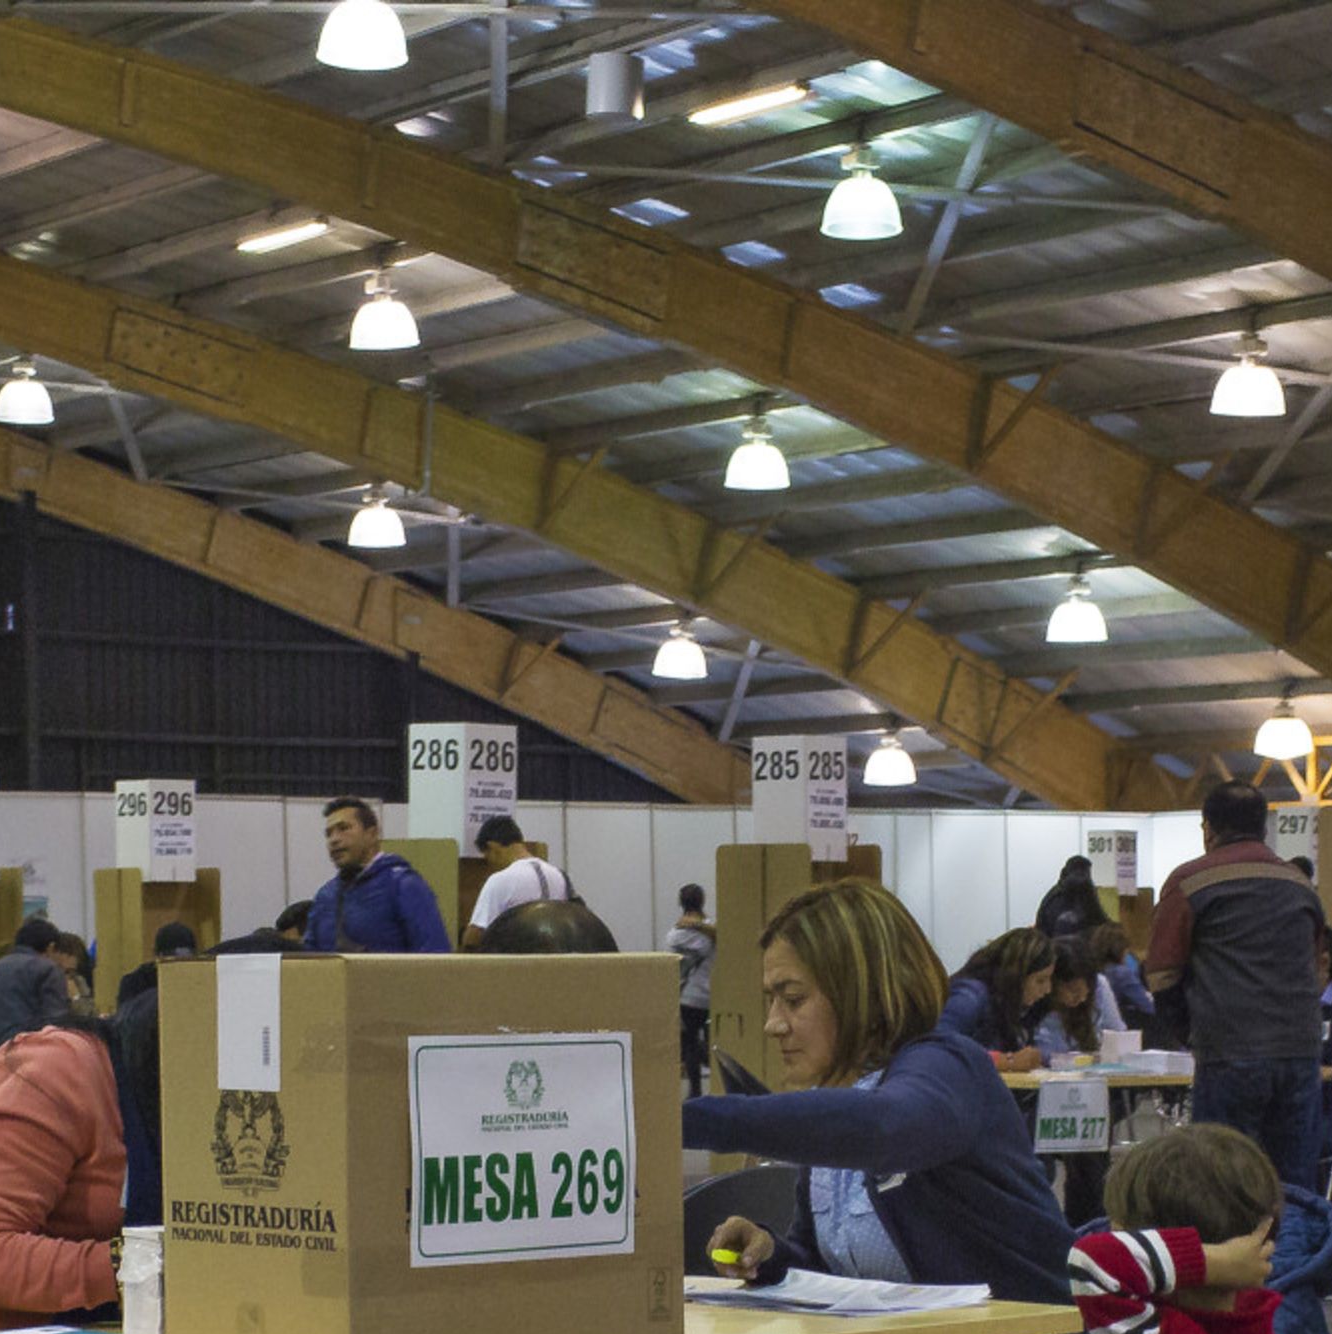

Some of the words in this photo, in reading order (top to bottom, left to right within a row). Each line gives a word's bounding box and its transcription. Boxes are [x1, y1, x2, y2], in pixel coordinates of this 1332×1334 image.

[412, 739, 459, 770] 286
[469, 738, 515, 772] 286
[754, 749, 799, 780] 285
[809, 751, 844, 780] 285
[117, 792, 147, 816] 296
[153, 791, 193, 816] 296
[1278, 814, 1308, 834] 297
[1088, 836, 1113, 853] 301
[1039, 1116, 1077, 1139] MESA
[1081, 1117, 1106, 1139] 277
[423, 1151, 539, 1226] MESA
[551, 1148, 625, 1218] 269
[171, 1200, 337, 1233] REGISTRADURÍA
[172, 1226, 228, 1244] NACIONAL
[229, 1231, 253, 1245] DEL
[255, 1233, 302, 1249] ESTADO
[304, 1236, 338, 1251] CIVIL
